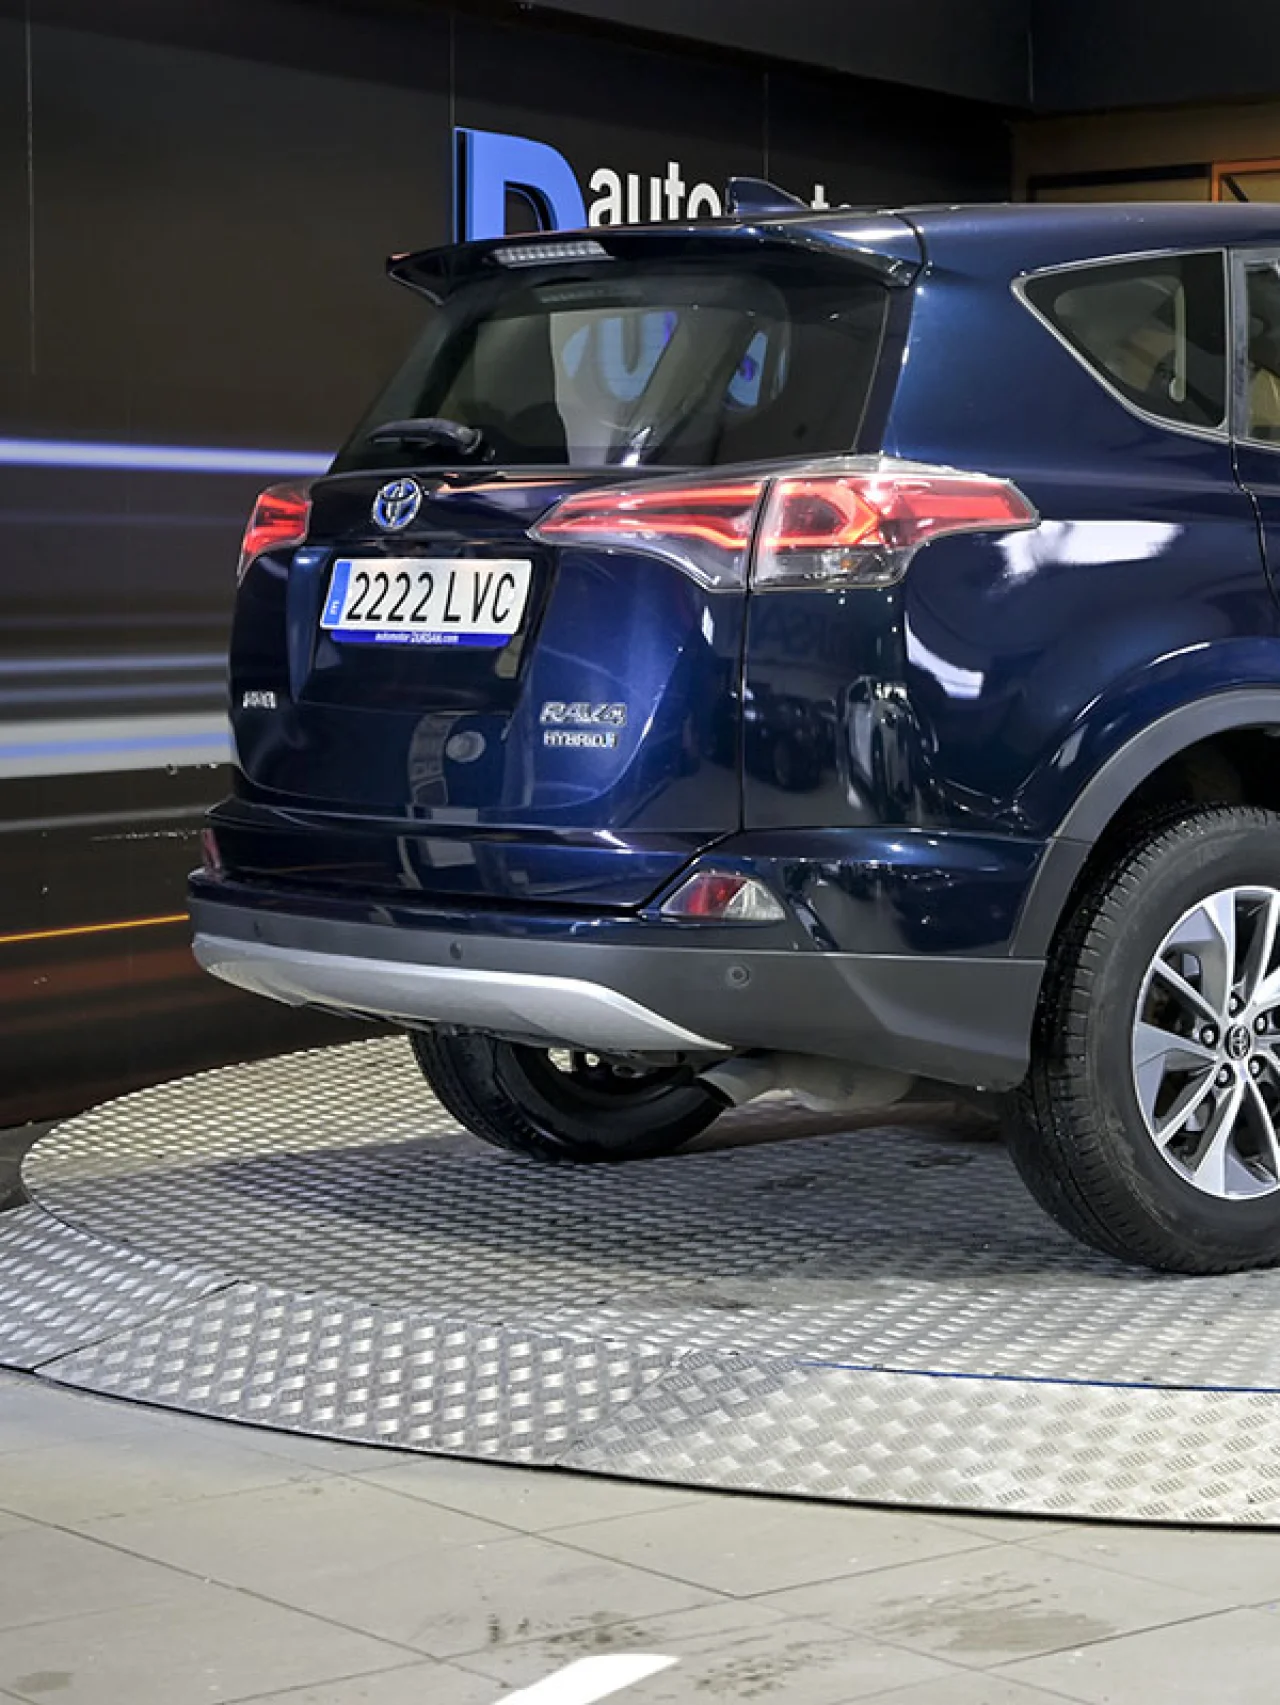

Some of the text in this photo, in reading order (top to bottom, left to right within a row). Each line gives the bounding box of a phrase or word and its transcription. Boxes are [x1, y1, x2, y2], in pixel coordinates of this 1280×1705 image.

[345, 571, 435, 623] 2222
[442, 570, 516, 624] LVC
[540, 701, 627, 727] RAV4
